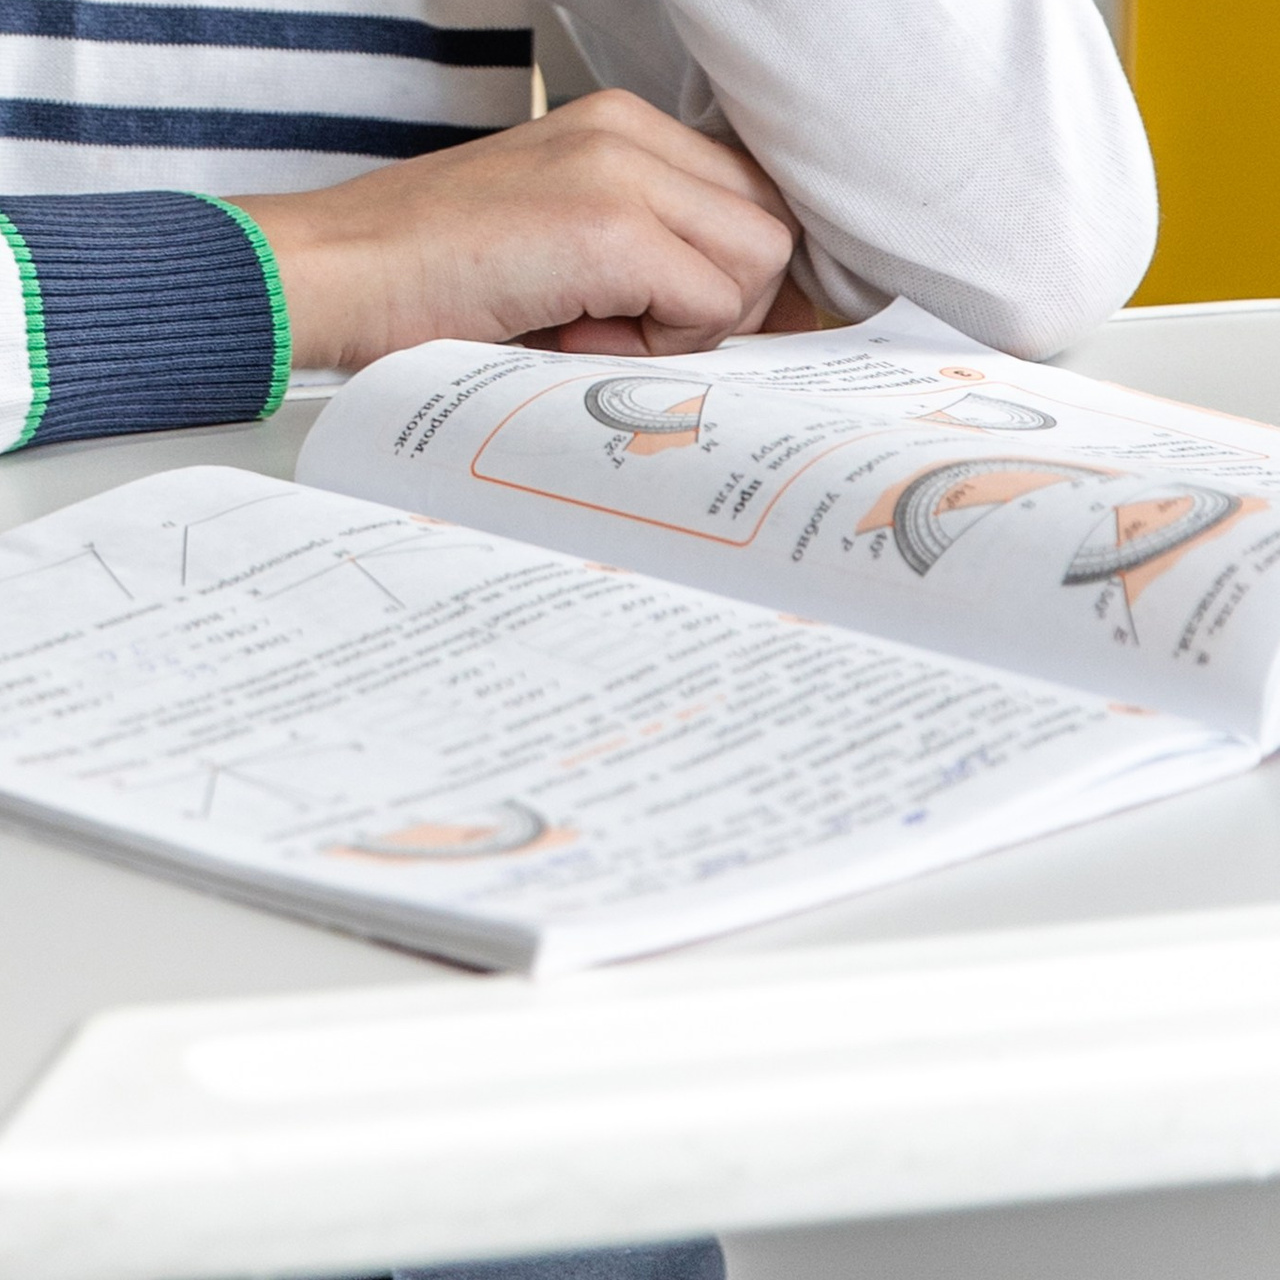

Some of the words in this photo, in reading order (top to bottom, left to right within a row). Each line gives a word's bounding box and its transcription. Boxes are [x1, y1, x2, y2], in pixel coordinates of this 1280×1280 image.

[393, 393, 446, 456] нахож-
[408, 362, 537, 459] транспортиром.
[731, 480, 763, 521] про-
[790, 491, 841, 563] удобно
